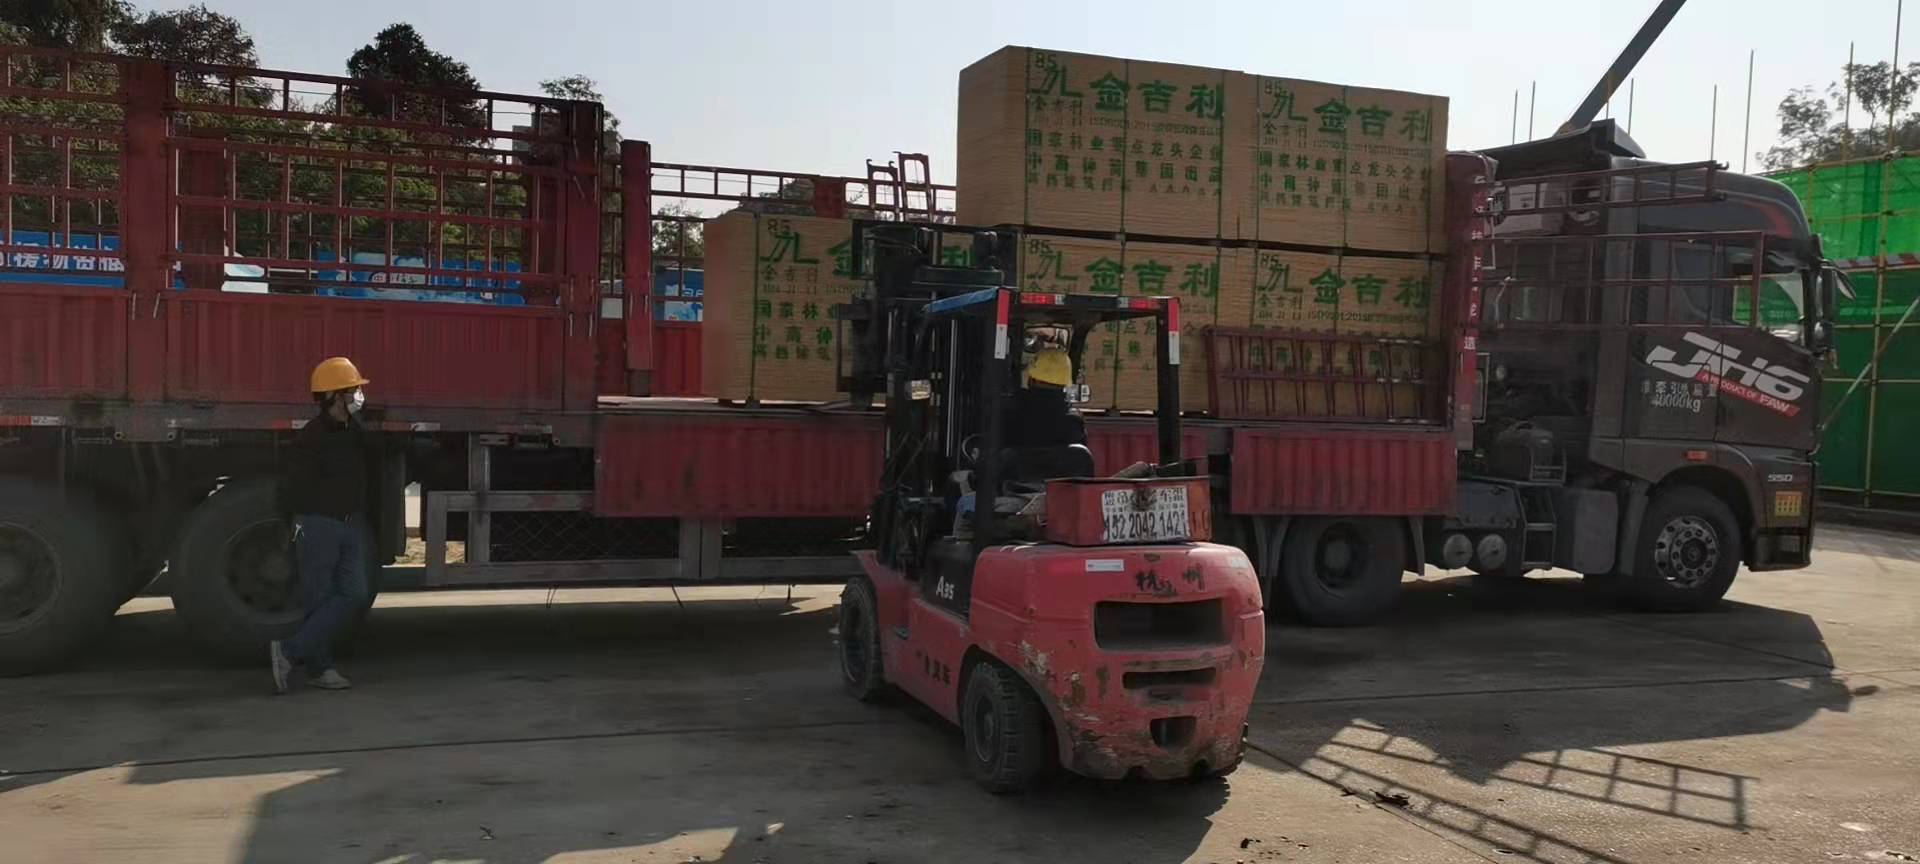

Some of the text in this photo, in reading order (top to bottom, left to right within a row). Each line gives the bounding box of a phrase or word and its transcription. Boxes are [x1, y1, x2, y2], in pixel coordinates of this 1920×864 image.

[1035, 53, 1057, 68] 85
[1089, 70, 1223, 119] 金吉利
[1264, 80, 1281, 95] 85
[1313, 98, 1433, 141] 金吉利
[768, 219, 791, 235] 85
[1027, 239, 1051, 254] 85
[1260, 253, 1279, 268] 85
[1087, 256, 1219, 298] 金吉利
[1310, 267, 1433, 308] 金吉利
[1760, 394, 1791, 413] FAW
[1129, 511, 1157, 538] 2042
[935, 575, 955, 600] A35
